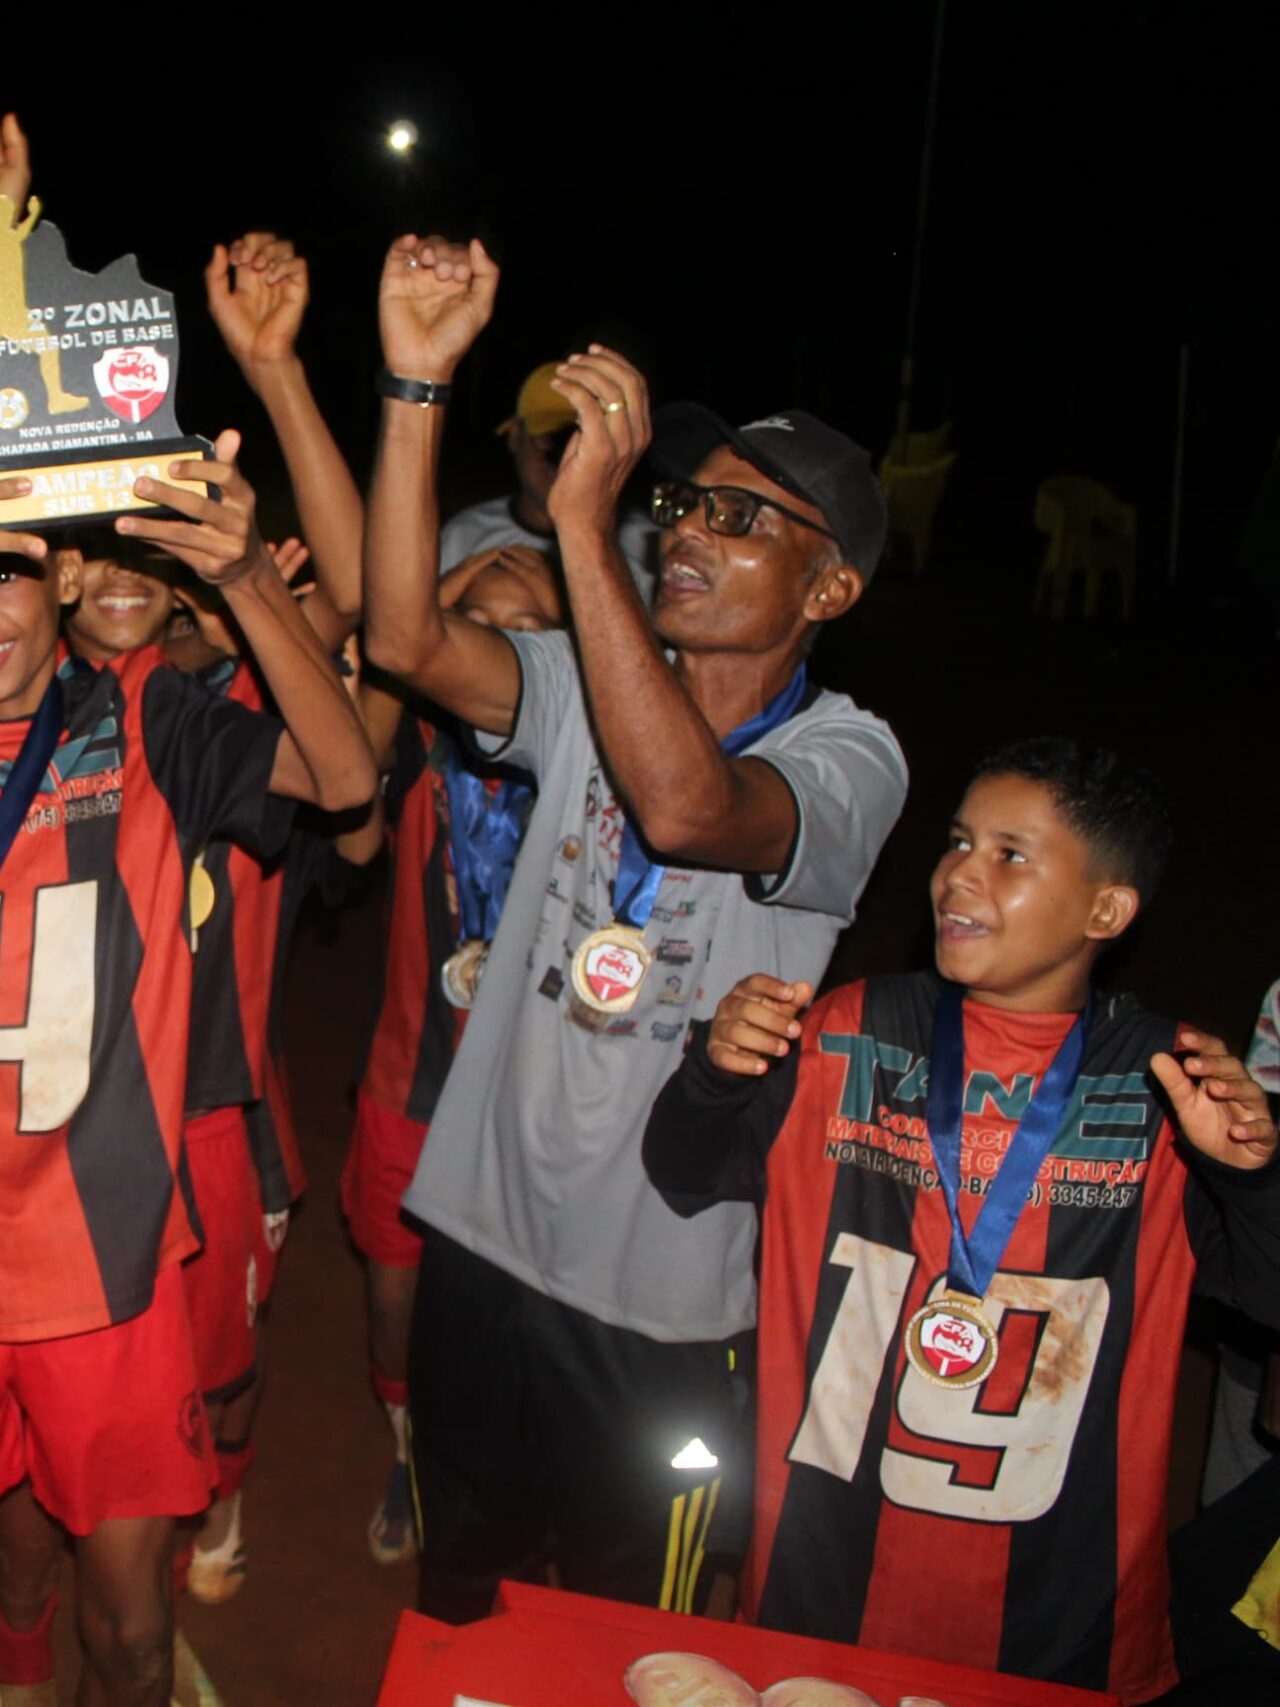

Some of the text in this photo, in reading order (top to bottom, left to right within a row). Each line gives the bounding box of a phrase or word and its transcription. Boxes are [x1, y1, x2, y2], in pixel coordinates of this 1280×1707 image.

[64, 296, 171, 329] ZONAL
[90, 329, 118, 347] DE
[122, 323, 175, 344] BASE
[19, 417, 120, 439] NOVA REDENÇÃO
[51, 432, 128, 451] DIAMANTINA
[136, 429, 154, 442] BA
[31, 461, 160, 498] AMPEÃO
[43, 490, 132, 519] SUB 13
[787, 1232, 1111, 1523] 19
